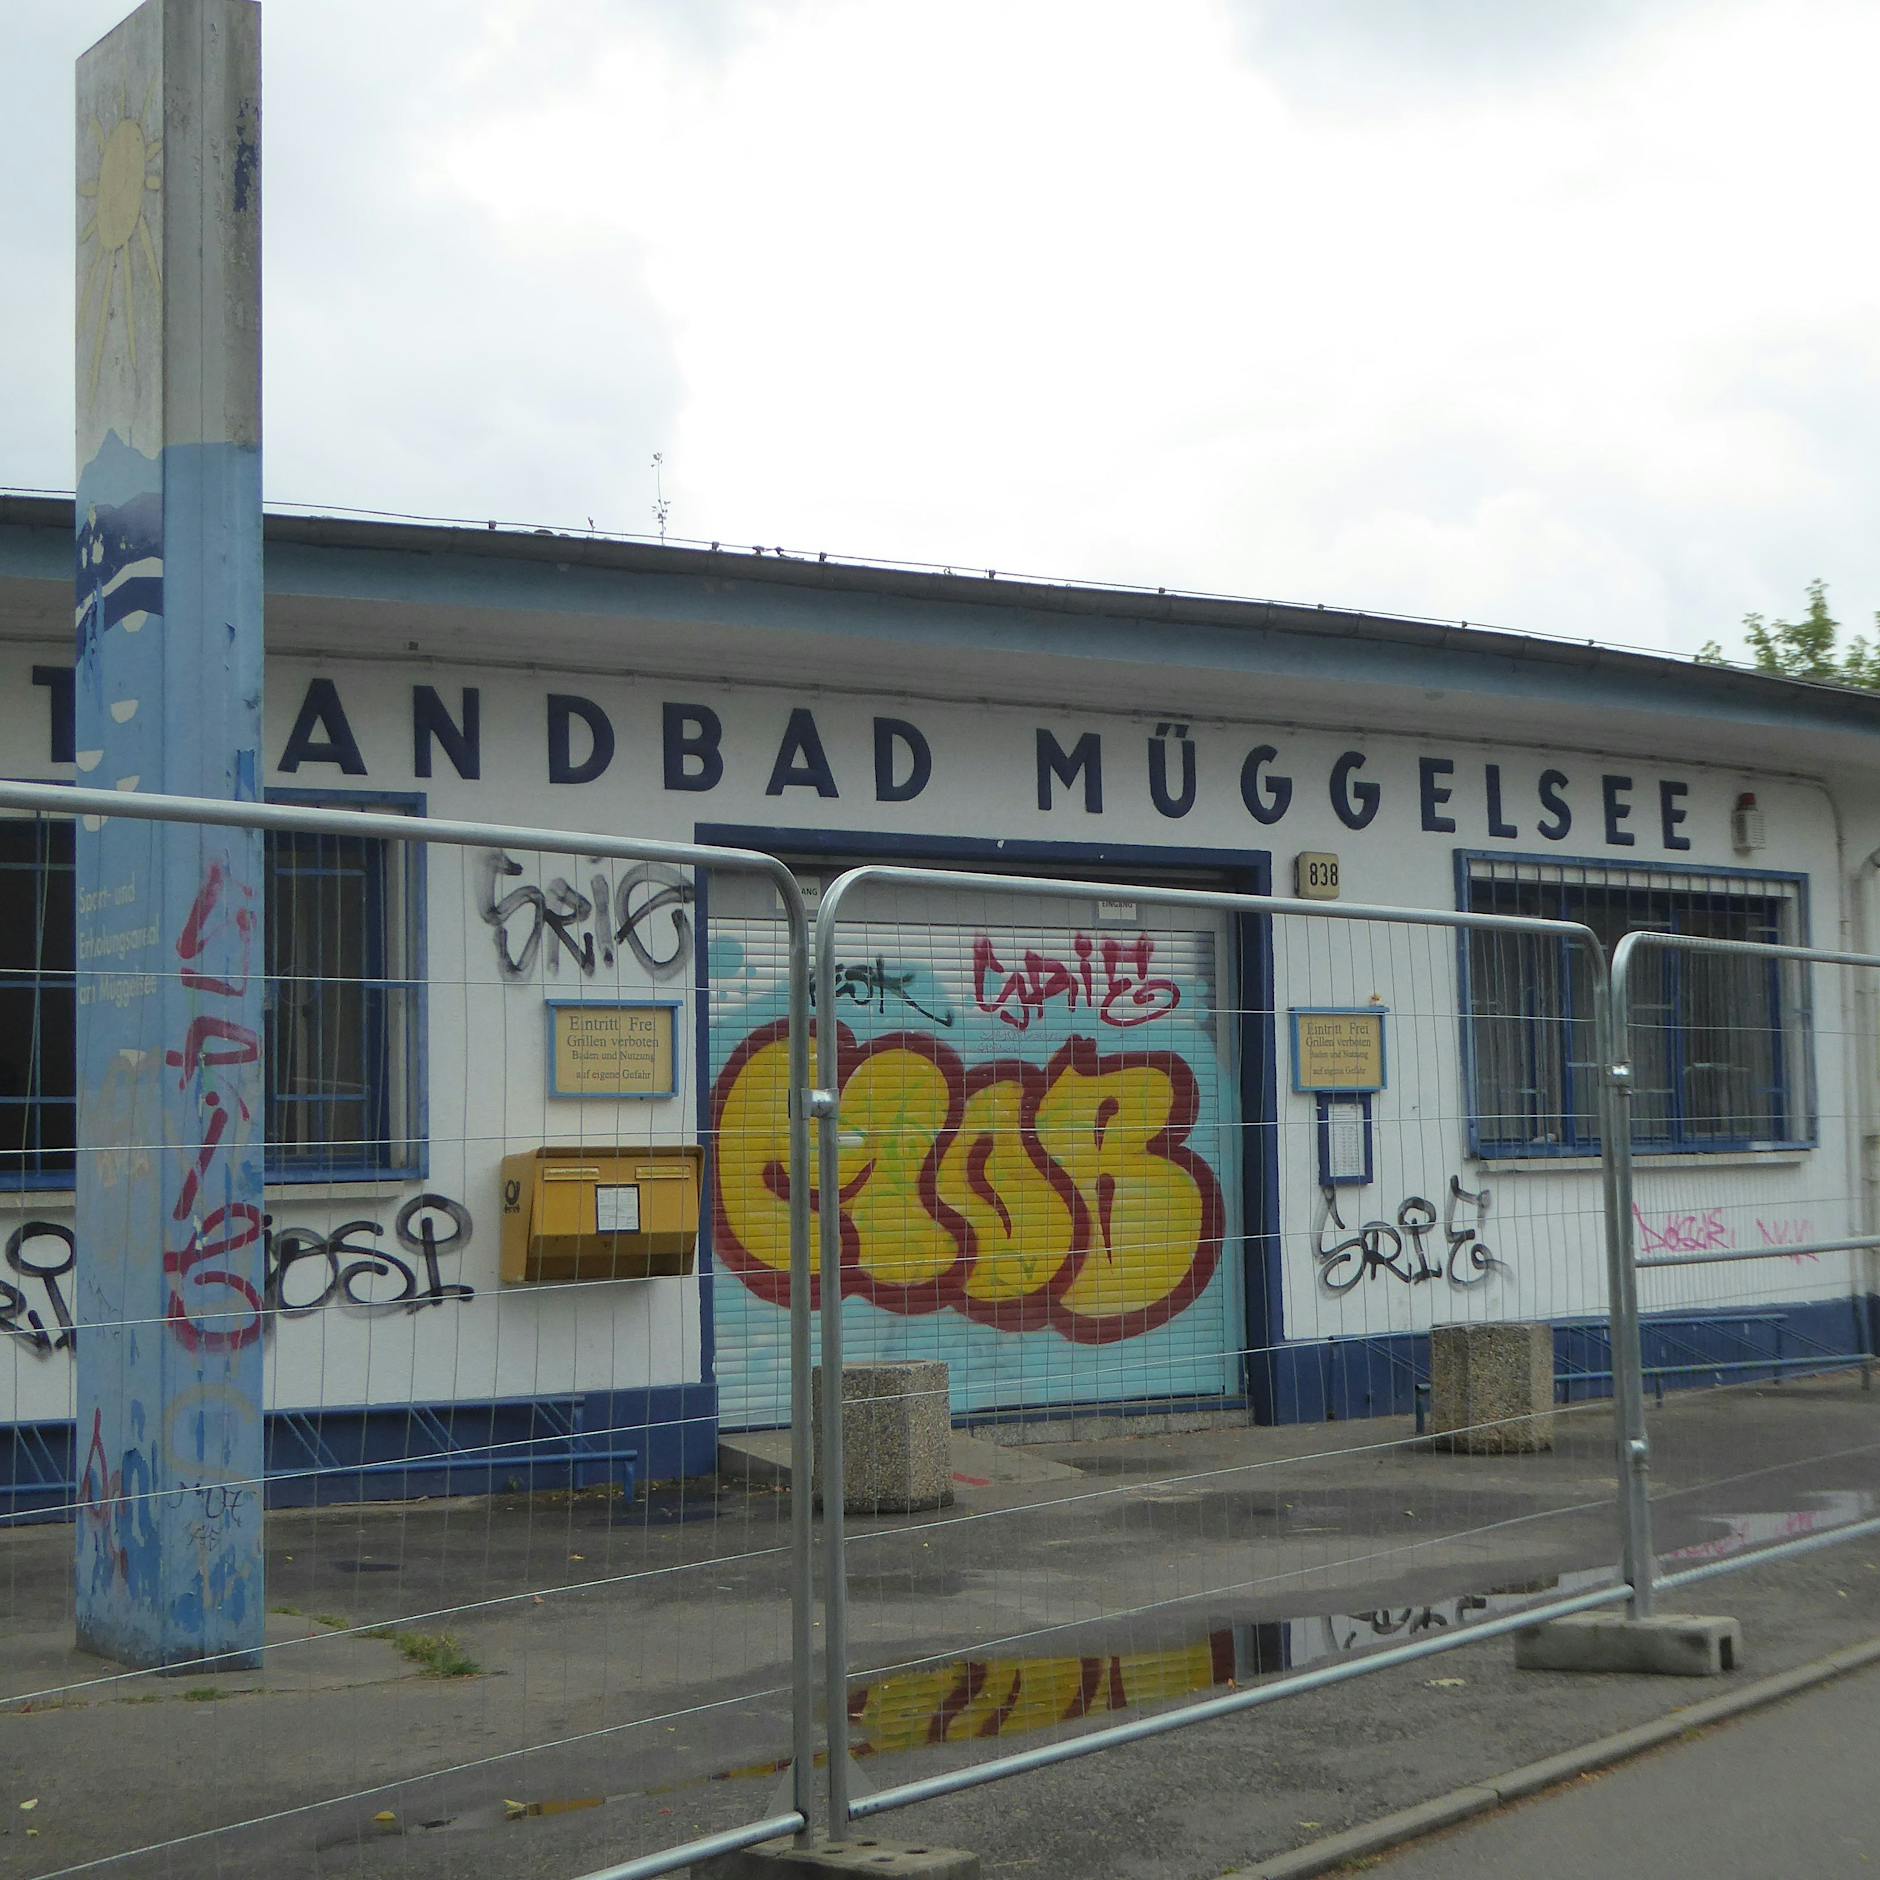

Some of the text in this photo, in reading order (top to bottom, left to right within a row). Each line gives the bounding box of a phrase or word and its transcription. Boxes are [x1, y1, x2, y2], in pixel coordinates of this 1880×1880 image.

[32, 665, 1691, 851] TANDBAD MÜGGELSEE
[1308, 861, 1339, 888] 838
[569, 1016, 655, 1031] Eintritt Frei
[1307, 1022, 1369, 1035] Eintritt Frei
[567, 1035, 659, 1048] Grillen verboten
[1305, 1036, 1371, 1047] Grillen verboten
[601, 1050, 617, 1060] und
